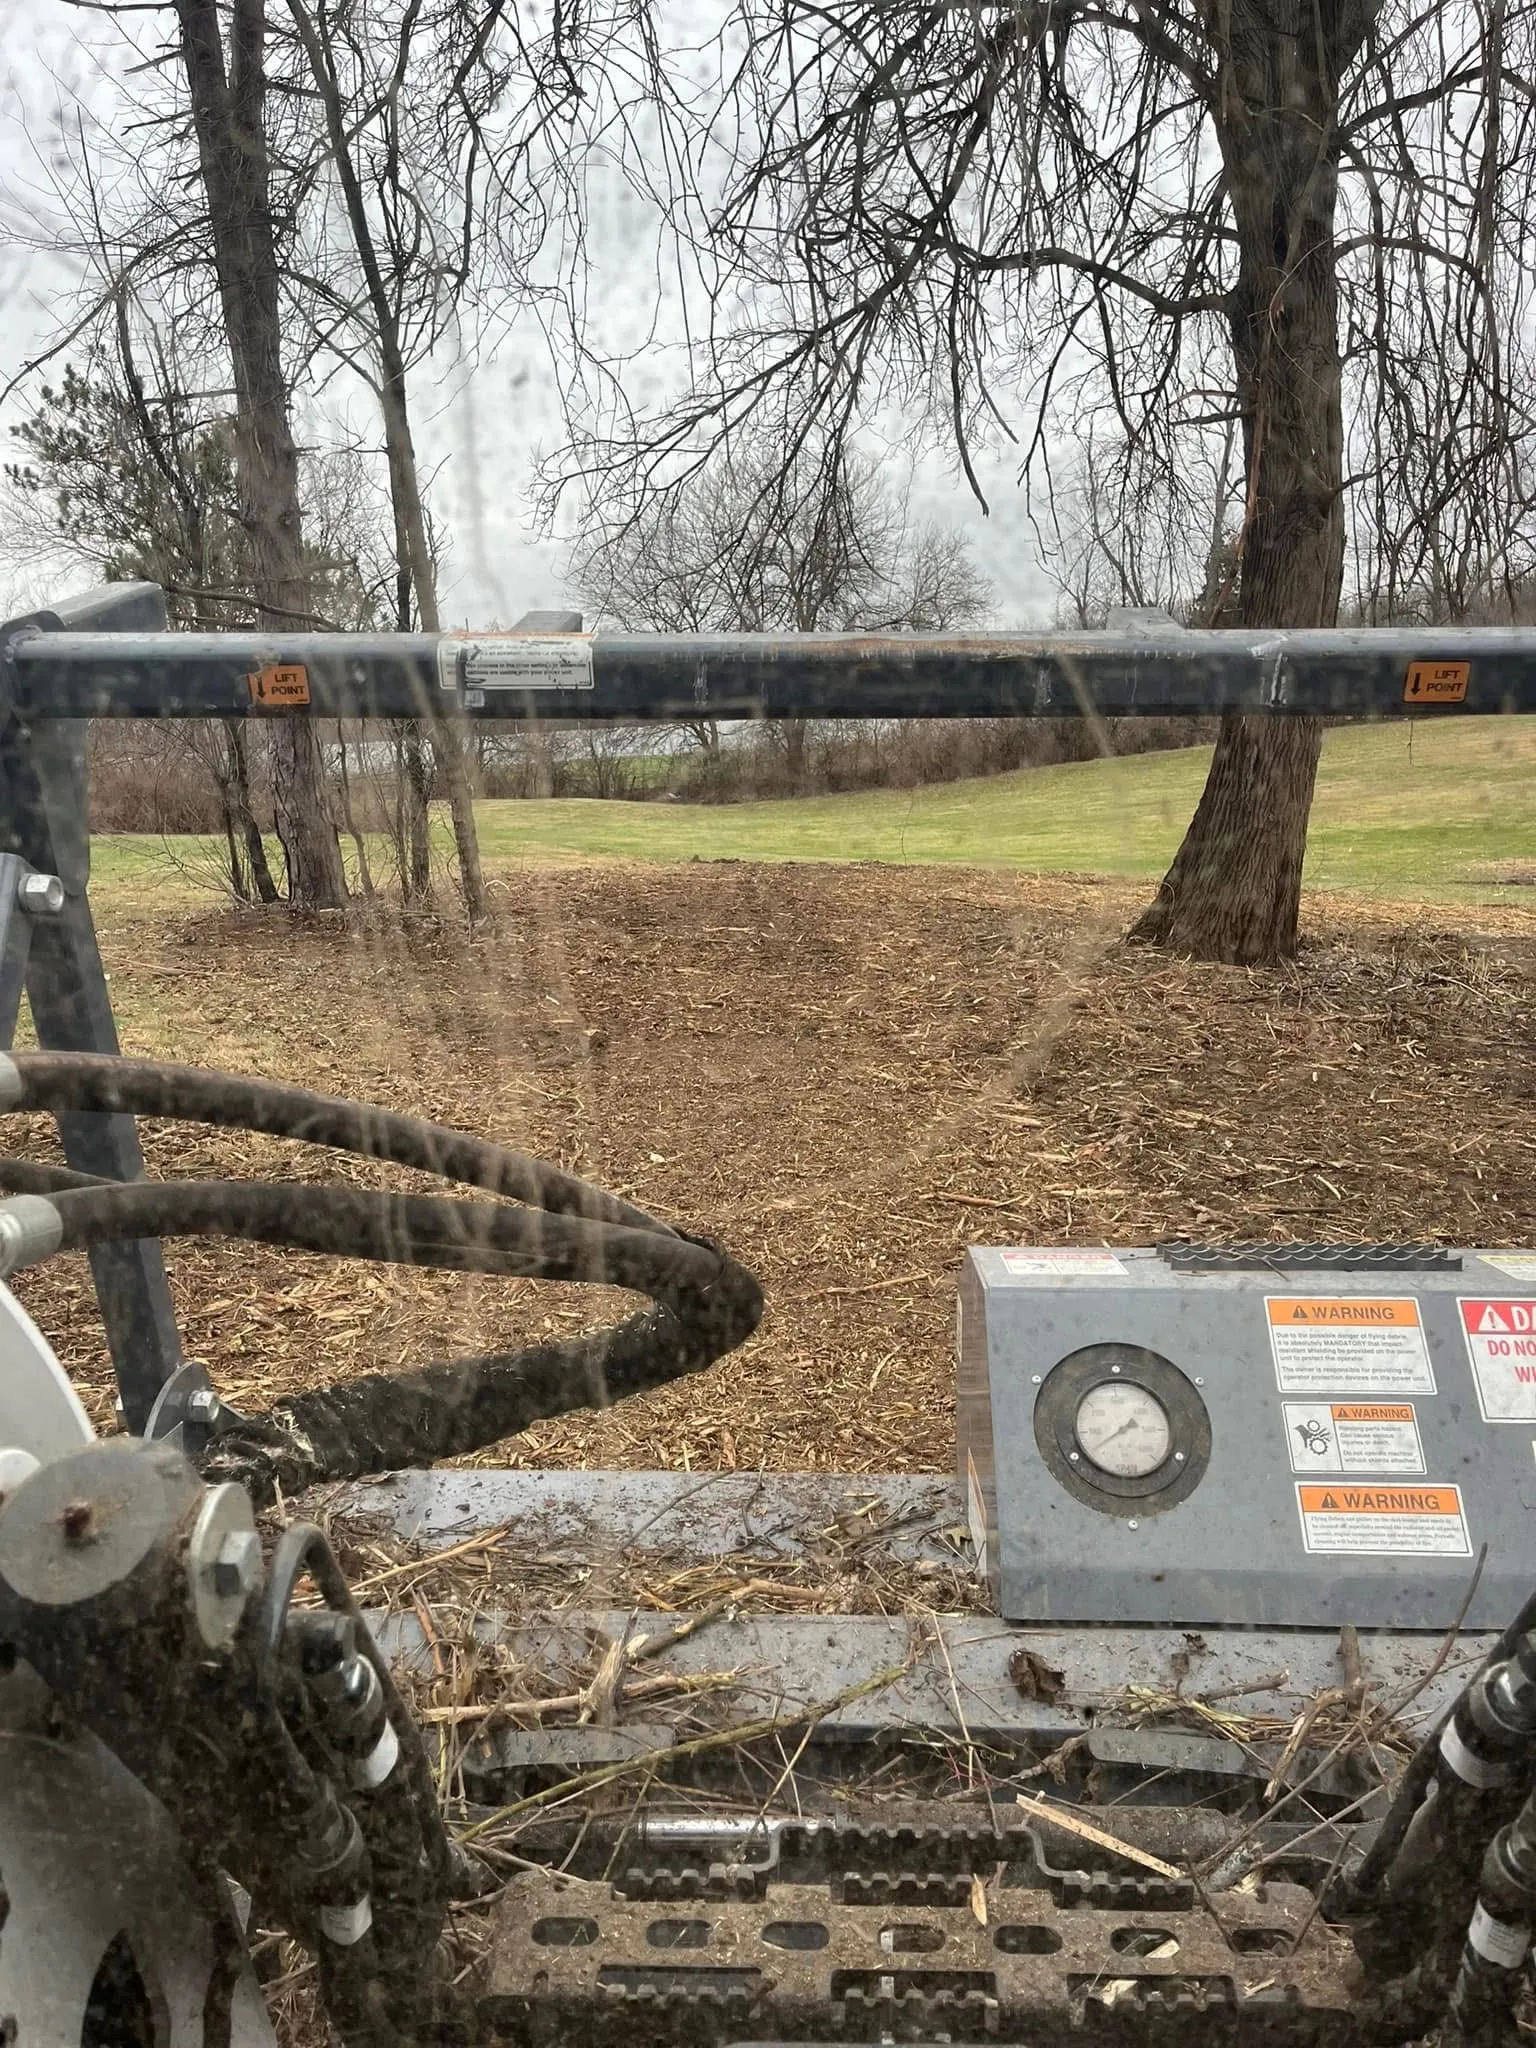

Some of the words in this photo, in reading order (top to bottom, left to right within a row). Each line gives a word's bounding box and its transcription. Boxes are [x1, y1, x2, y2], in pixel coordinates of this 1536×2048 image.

[275, 673, 297, 682] LIFT
[1435, 670, 1460, 679] LIFT
[272, 686, 304, 695] POINT
[1426, 683, 1463, 692] POINT
[1312, 1307, 1394, 1320] WARNING
[1511, 1306, 1536, 1331] D
[1488, 1340, 1510, 1356] DO
[1351, 1408, 1409, 1419] WARNING
[1344, 1493, 1440, 1510] WARNING
